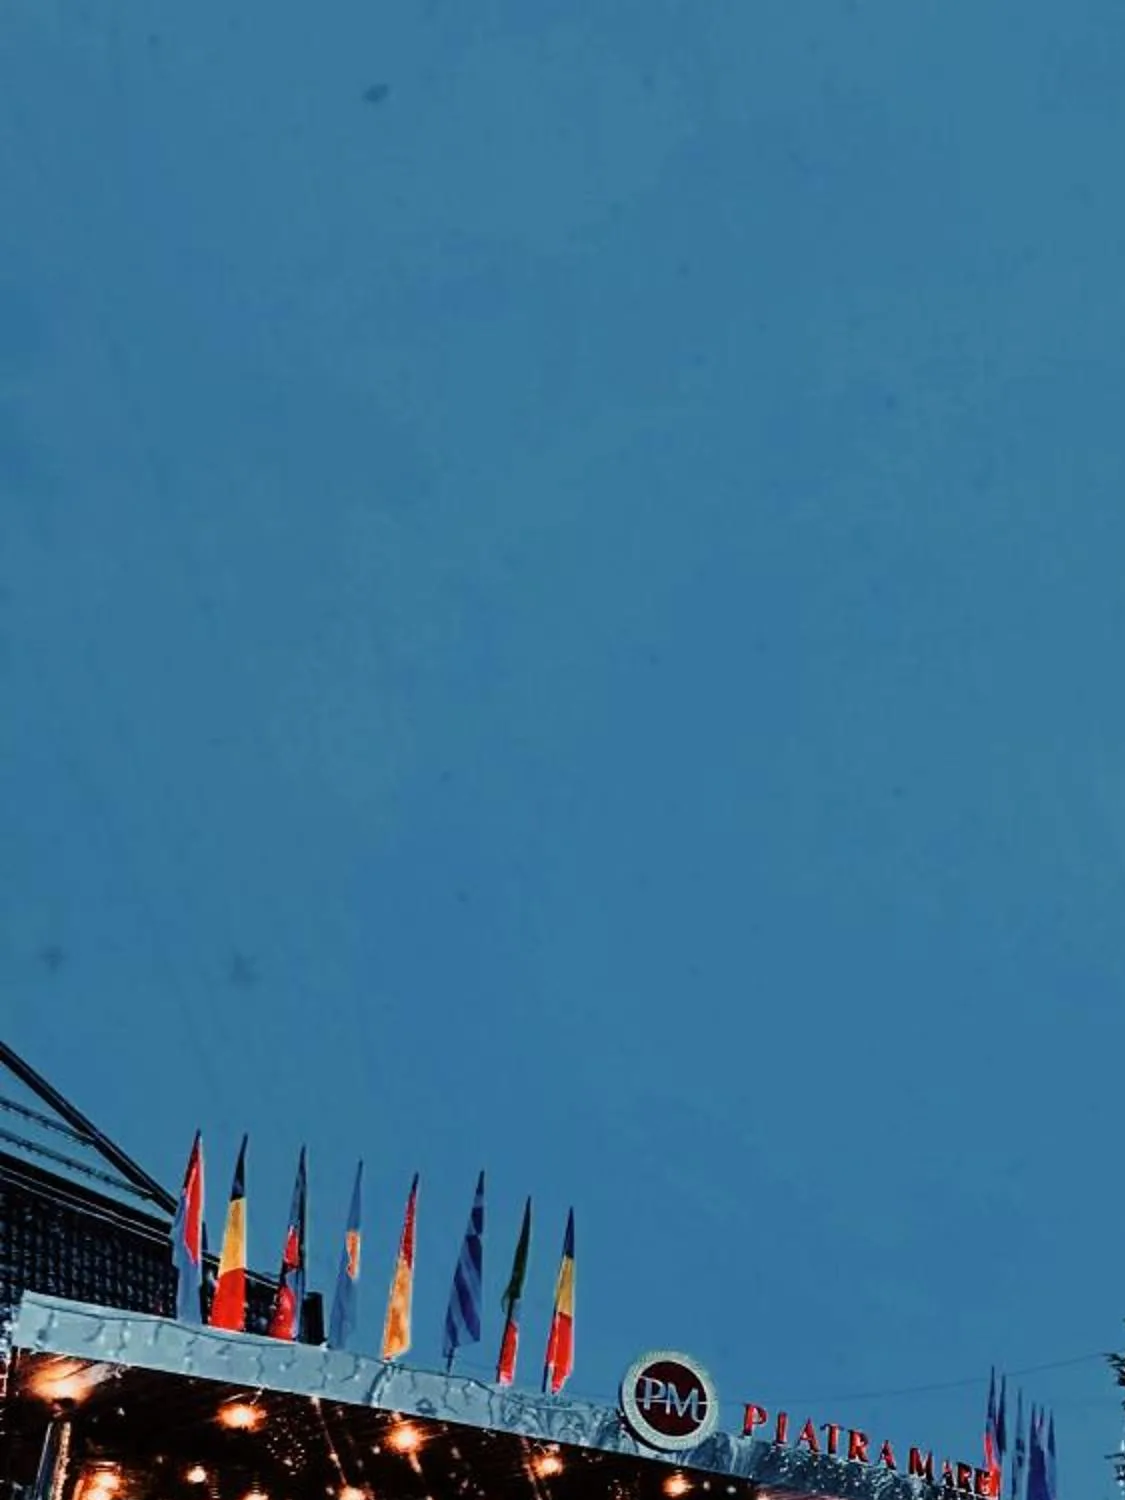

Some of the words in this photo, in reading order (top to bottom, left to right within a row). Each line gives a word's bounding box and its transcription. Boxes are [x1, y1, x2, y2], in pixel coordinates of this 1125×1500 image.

[637, 1375, 704, 1423] PM
[743, 1402, 897, 1470] PIATRA
[908, 1446, 995, 1498] MARE
